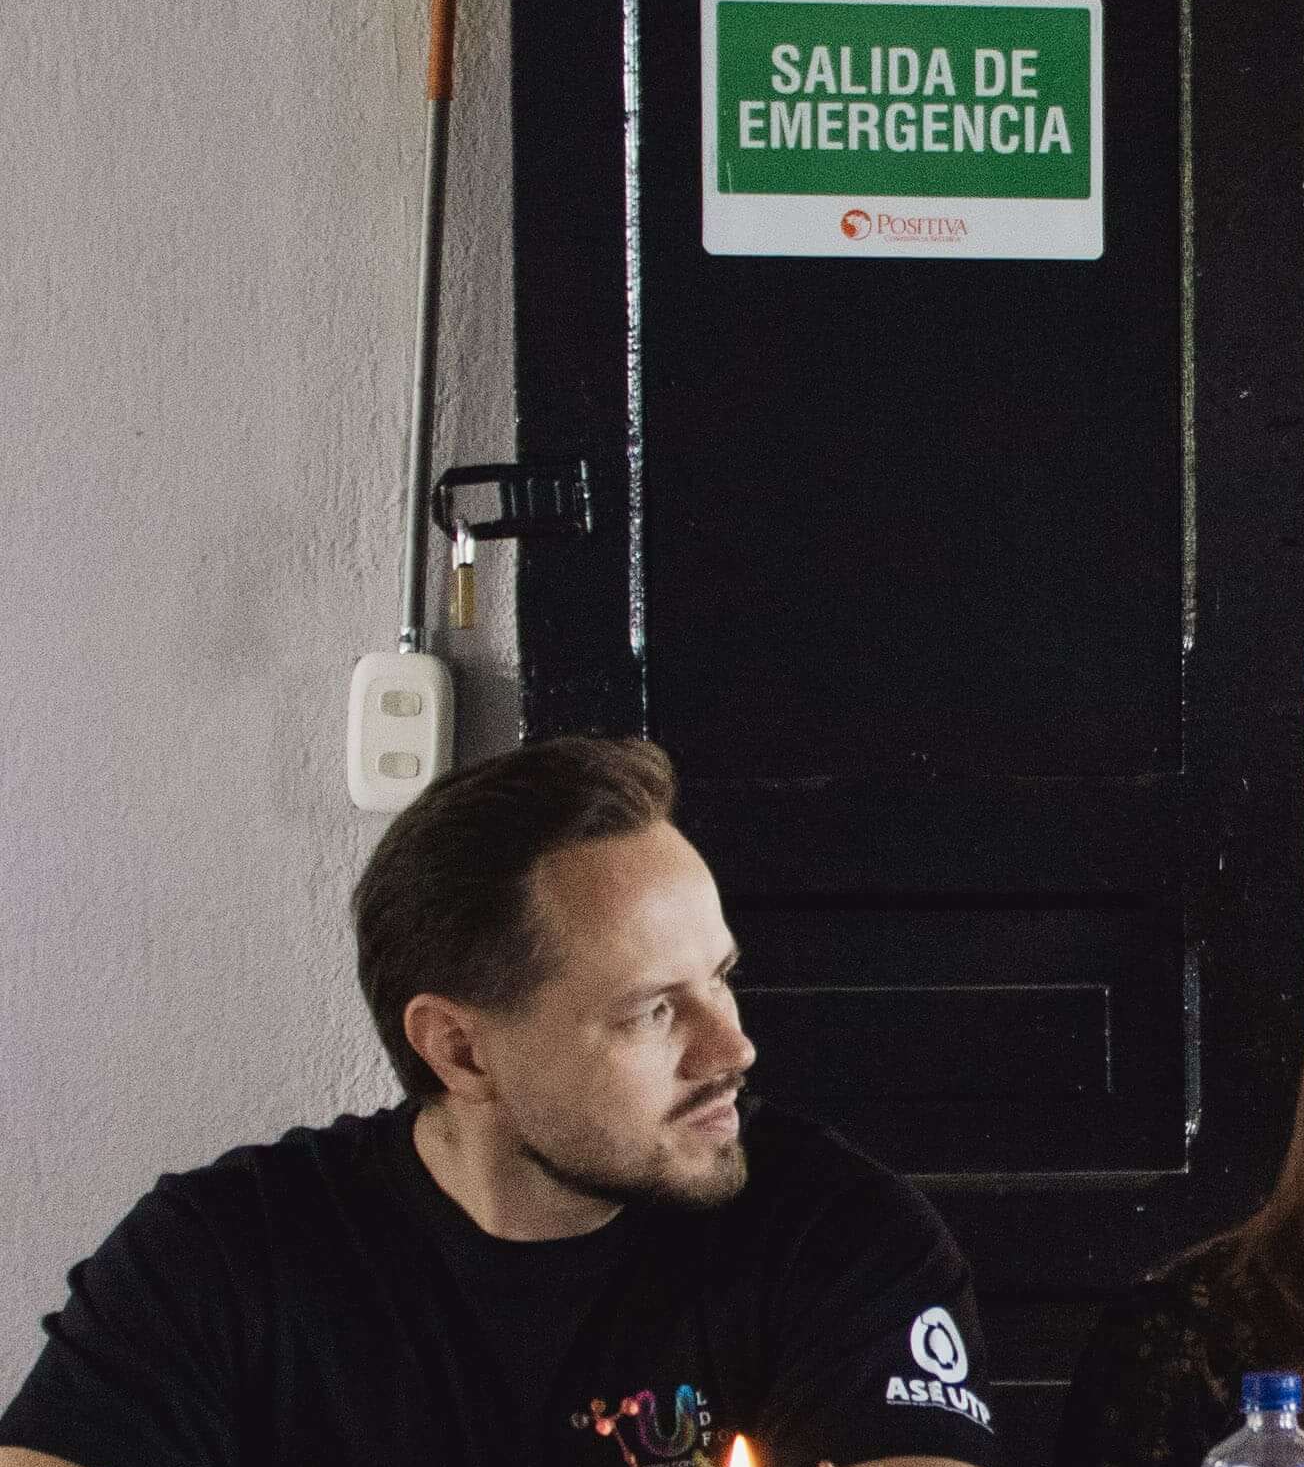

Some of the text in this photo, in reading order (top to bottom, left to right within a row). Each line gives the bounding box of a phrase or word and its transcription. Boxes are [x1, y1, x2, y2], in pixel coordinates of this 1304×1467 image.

[771, 44, 1039, 98] SALIDA DE
[739, 100, 1073, 154] EMERGENCIA
[877, 214, 968, 235] POSITIVA
